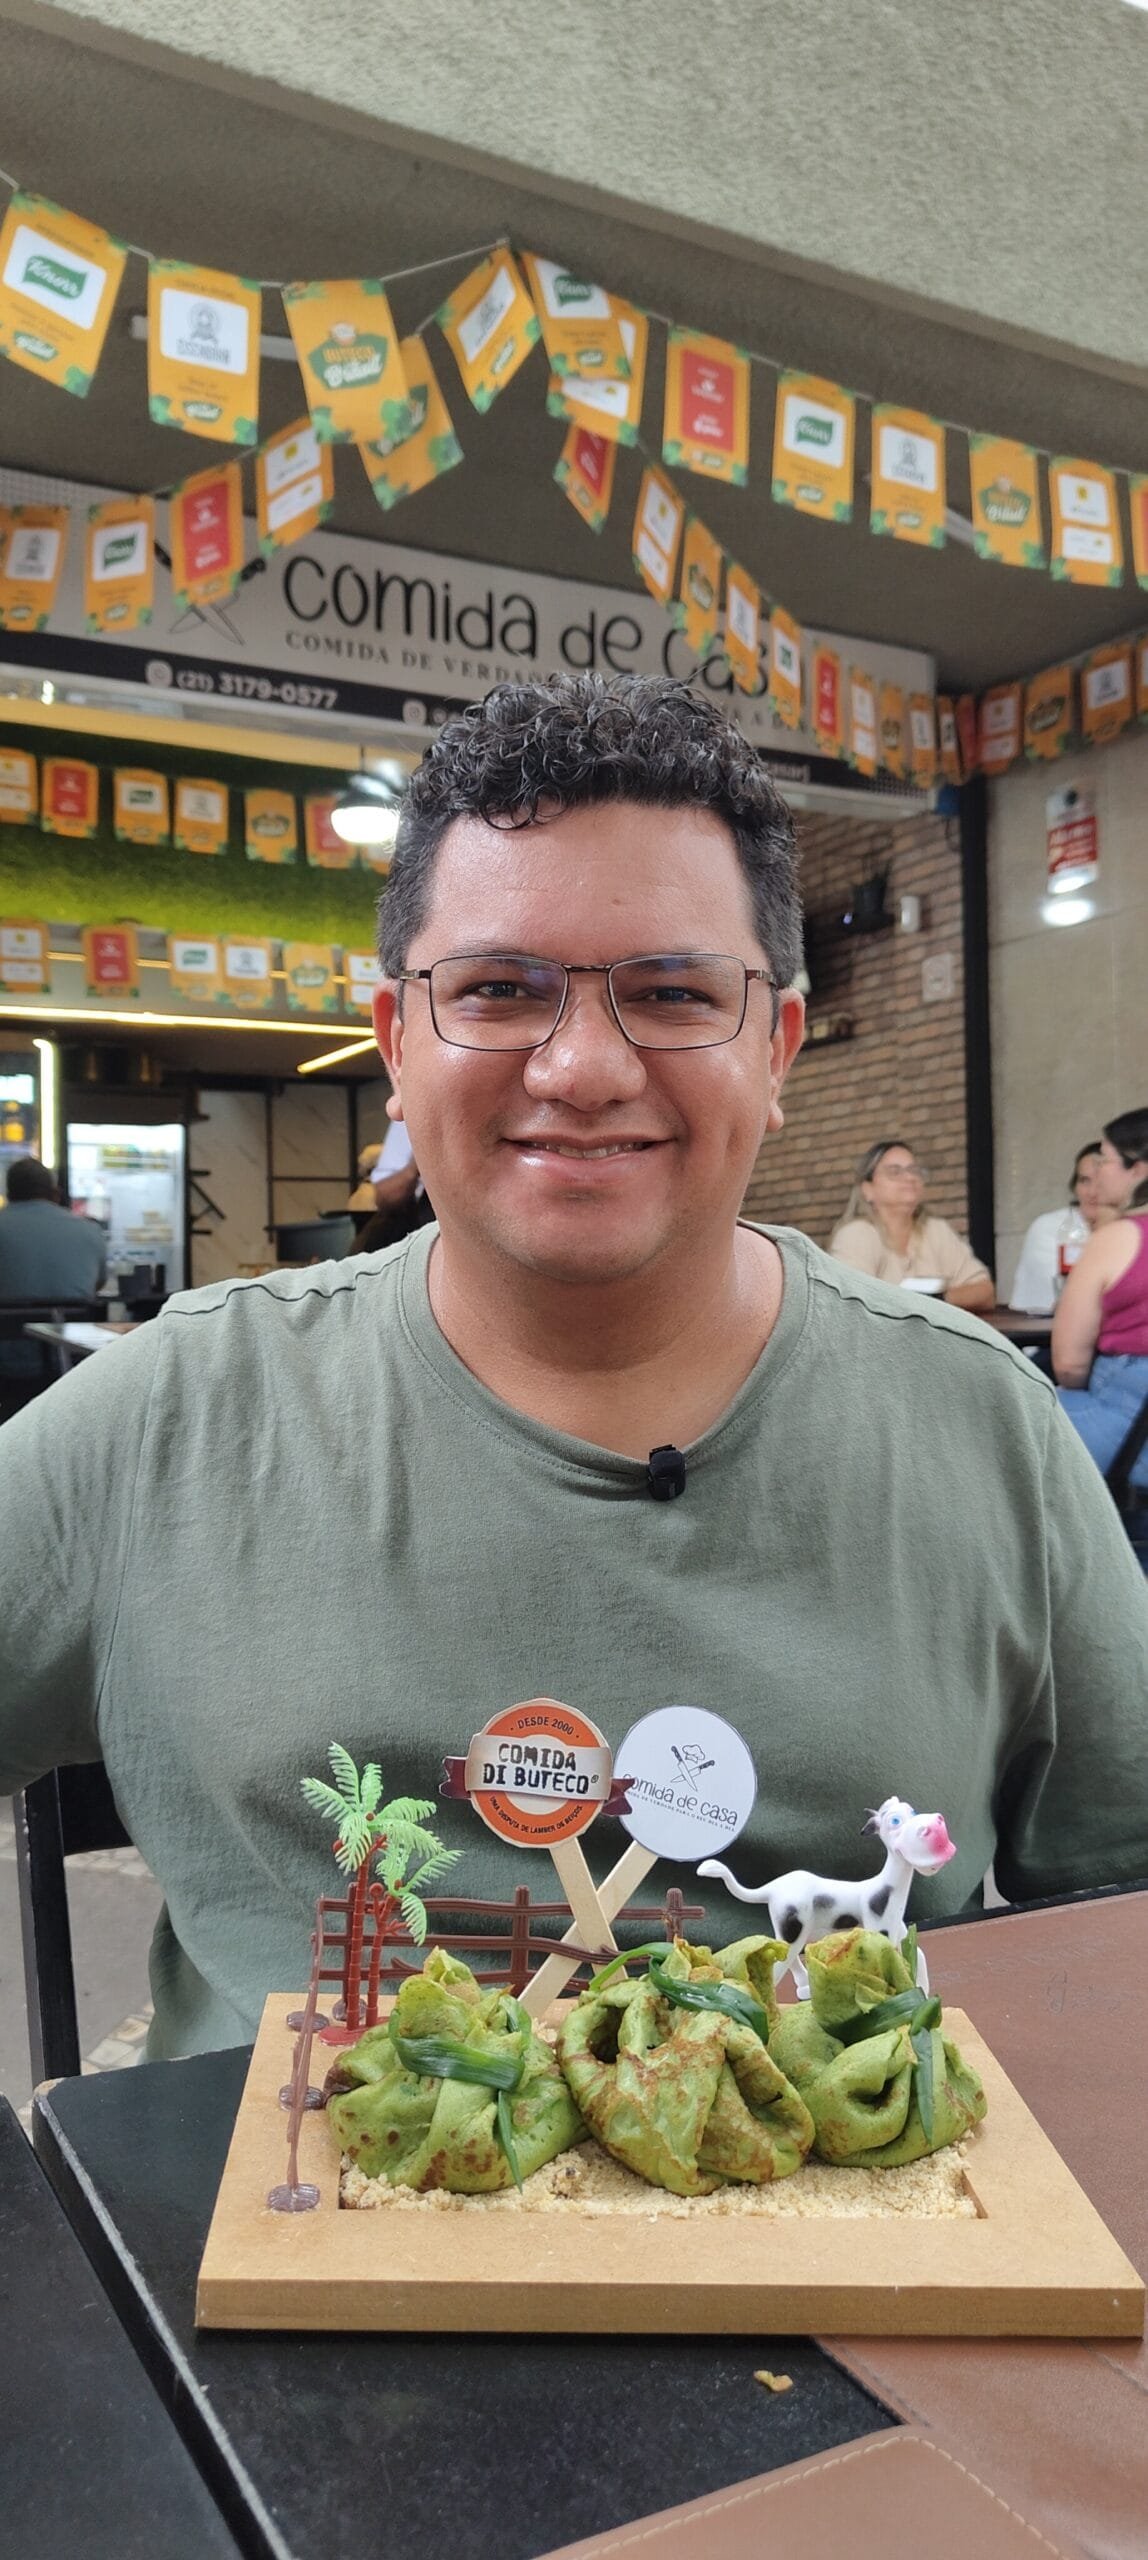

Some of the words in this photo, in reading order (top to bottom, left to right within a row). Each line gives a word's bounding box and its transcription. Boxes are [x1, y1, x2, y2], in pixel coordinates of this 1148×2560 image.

[284, 630, 390, 665] COMIDA
[401, 650, 432, 671] DE
[560, 608, 642, 674] de
[177, 670, 214, 693] (21)
[219, 673, 338, 711] 3179-0577
[518, 1716, 549, 1729] DESDE
[551, 1719, 575, 1735] 2000
[498, 1743, 577, 1771] COMIDA
[483, 1763, 507, 1785] DI
[498, 1809, 520, 1829] DISPUTA
[520, 1824, 530, 1833] DE
[530, 1824, 556, 1834] LAMBER
[676, 1794, 698, 1811] de
[700, 1801, 738, 1826] casa
